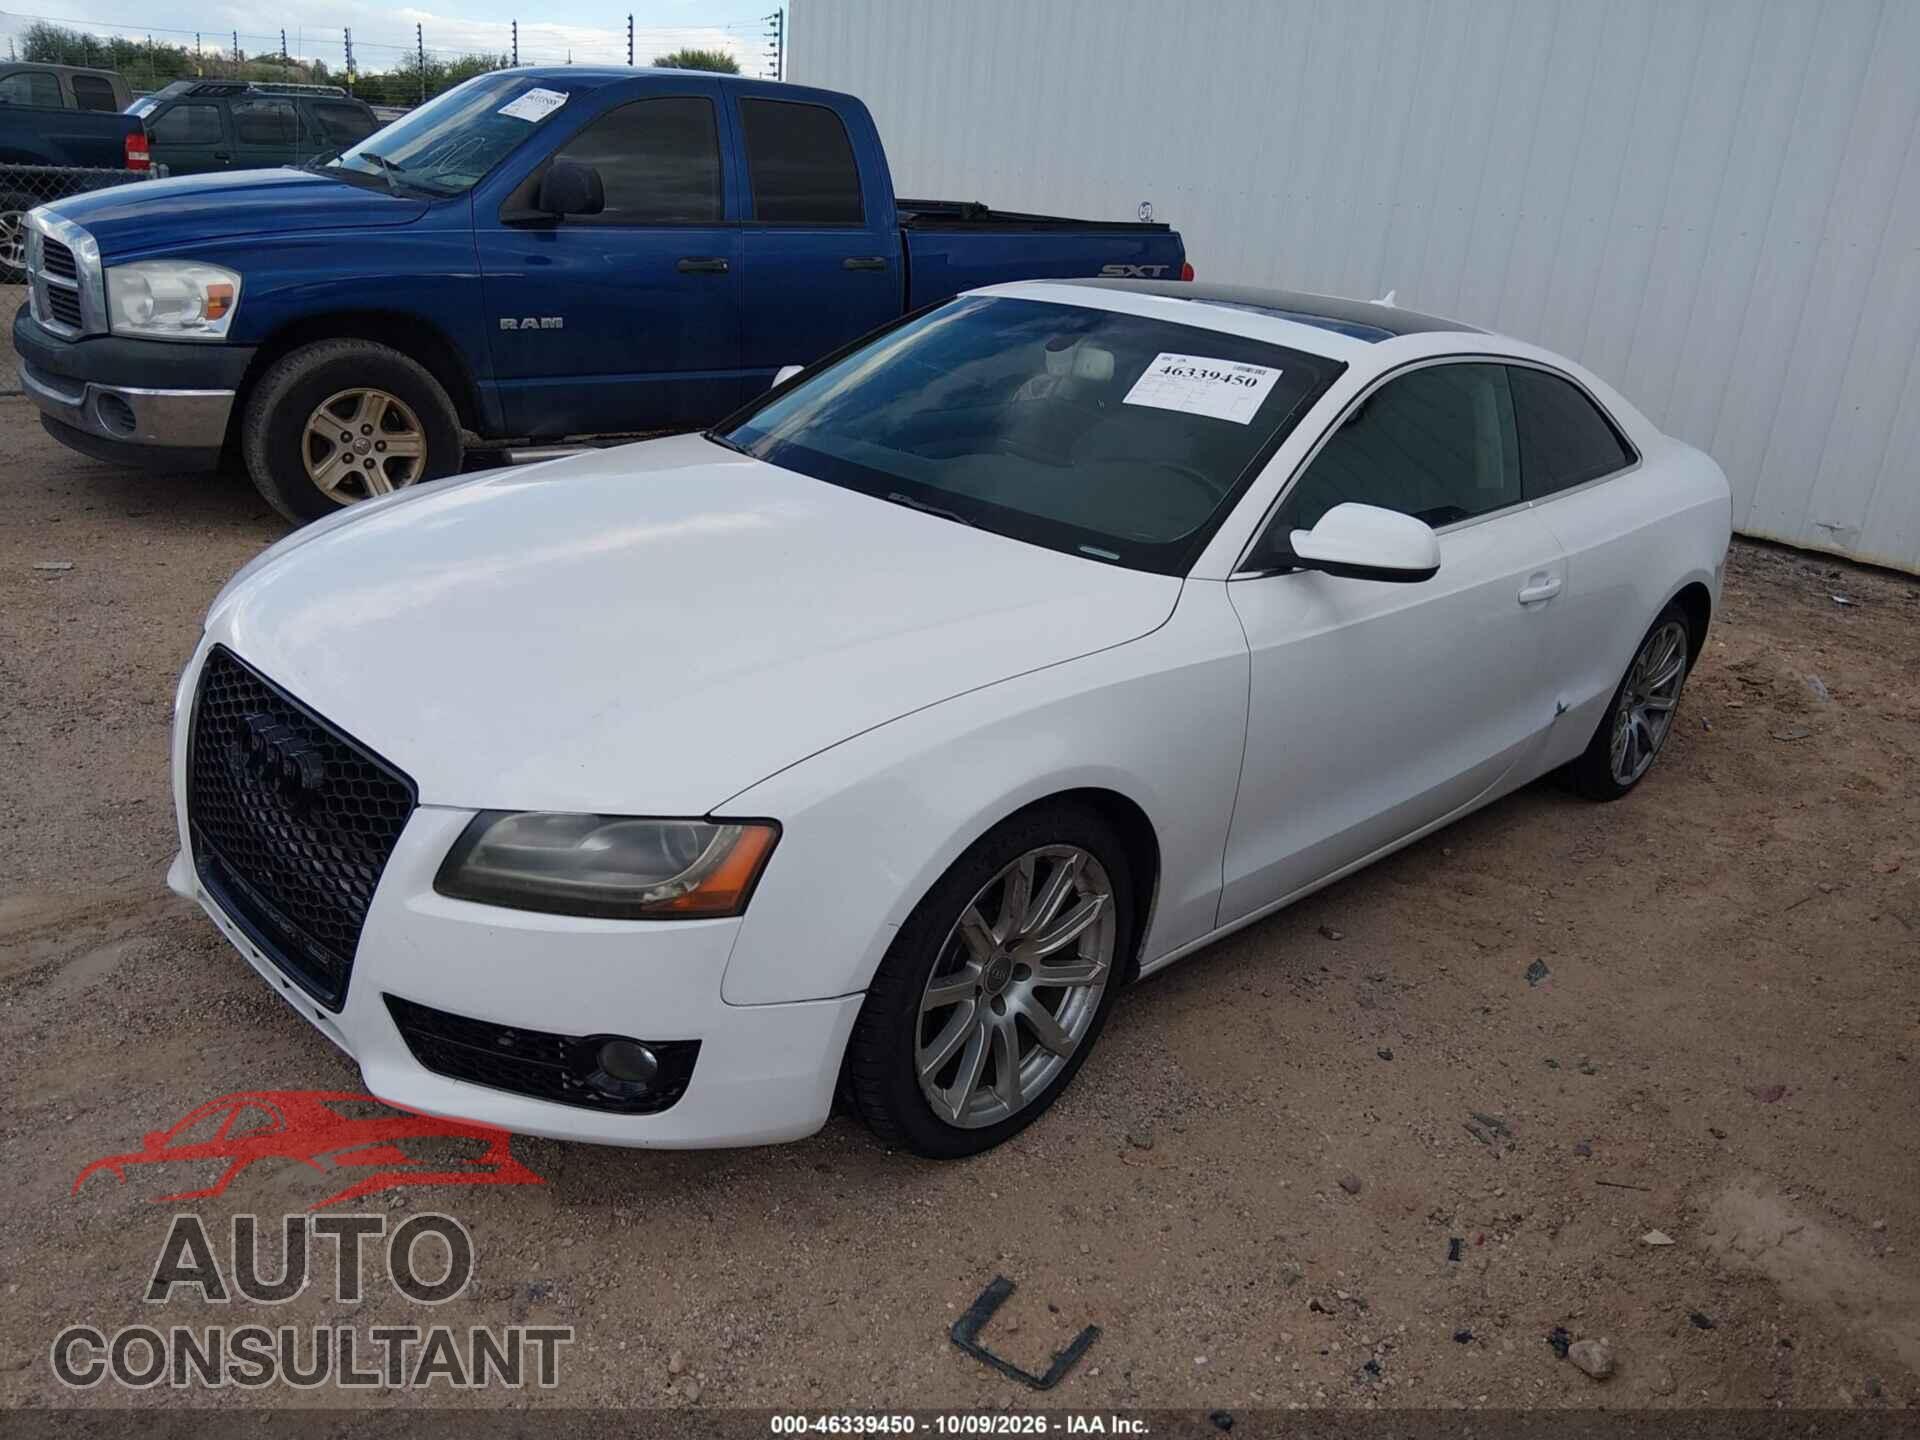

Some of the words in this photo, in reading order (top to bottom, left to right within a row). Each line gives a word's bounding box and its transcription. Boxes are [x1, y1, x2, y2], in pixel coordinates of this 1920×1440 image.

[1098, 265, 1169, 277] SXT
[500, 317, 563, 329] RAM
[1159, 365, 1258, 388] 46339450
